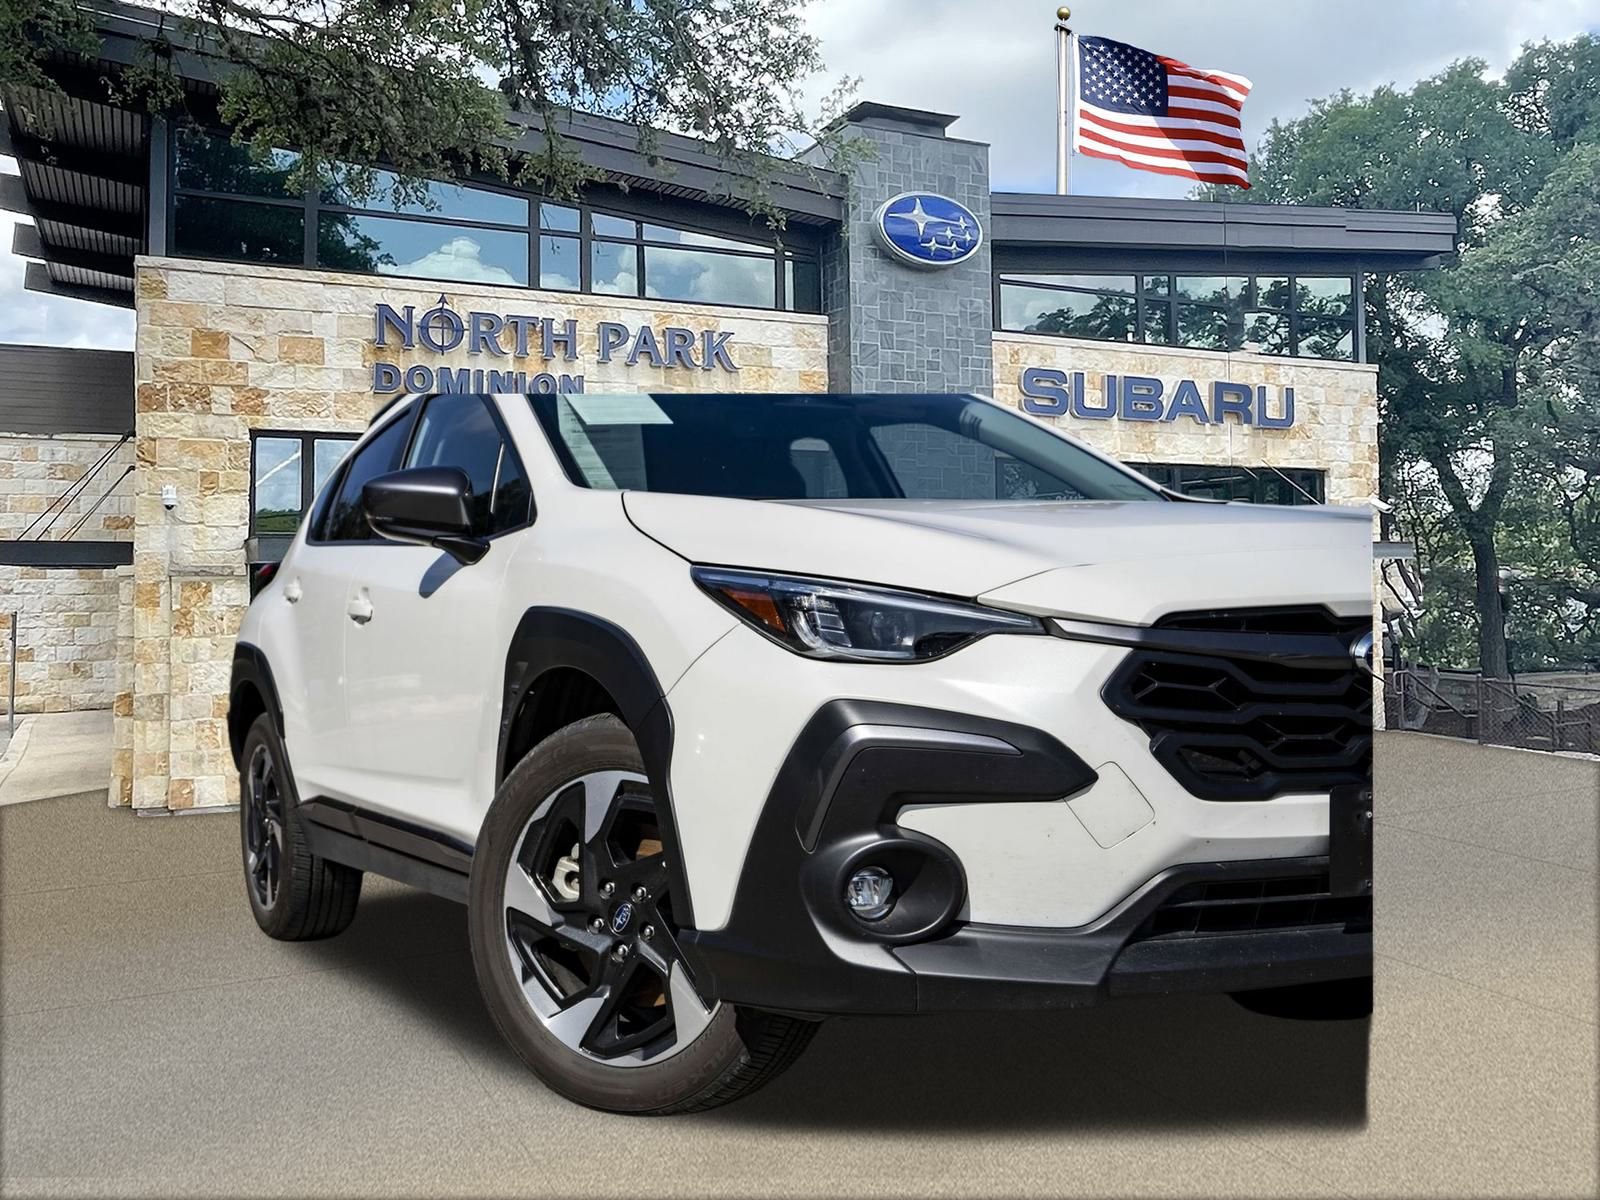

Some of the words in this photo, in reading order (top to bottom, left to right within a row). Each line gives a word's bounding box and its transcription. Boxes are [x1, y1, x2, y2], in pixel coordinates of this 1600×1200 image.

[374, 294, 580, 361] NORTH
[597, 320, 741, 374] PARK
[372, 361, 584, 394] DOMINION
[1018, 366, 1295, 430] SUBARU
